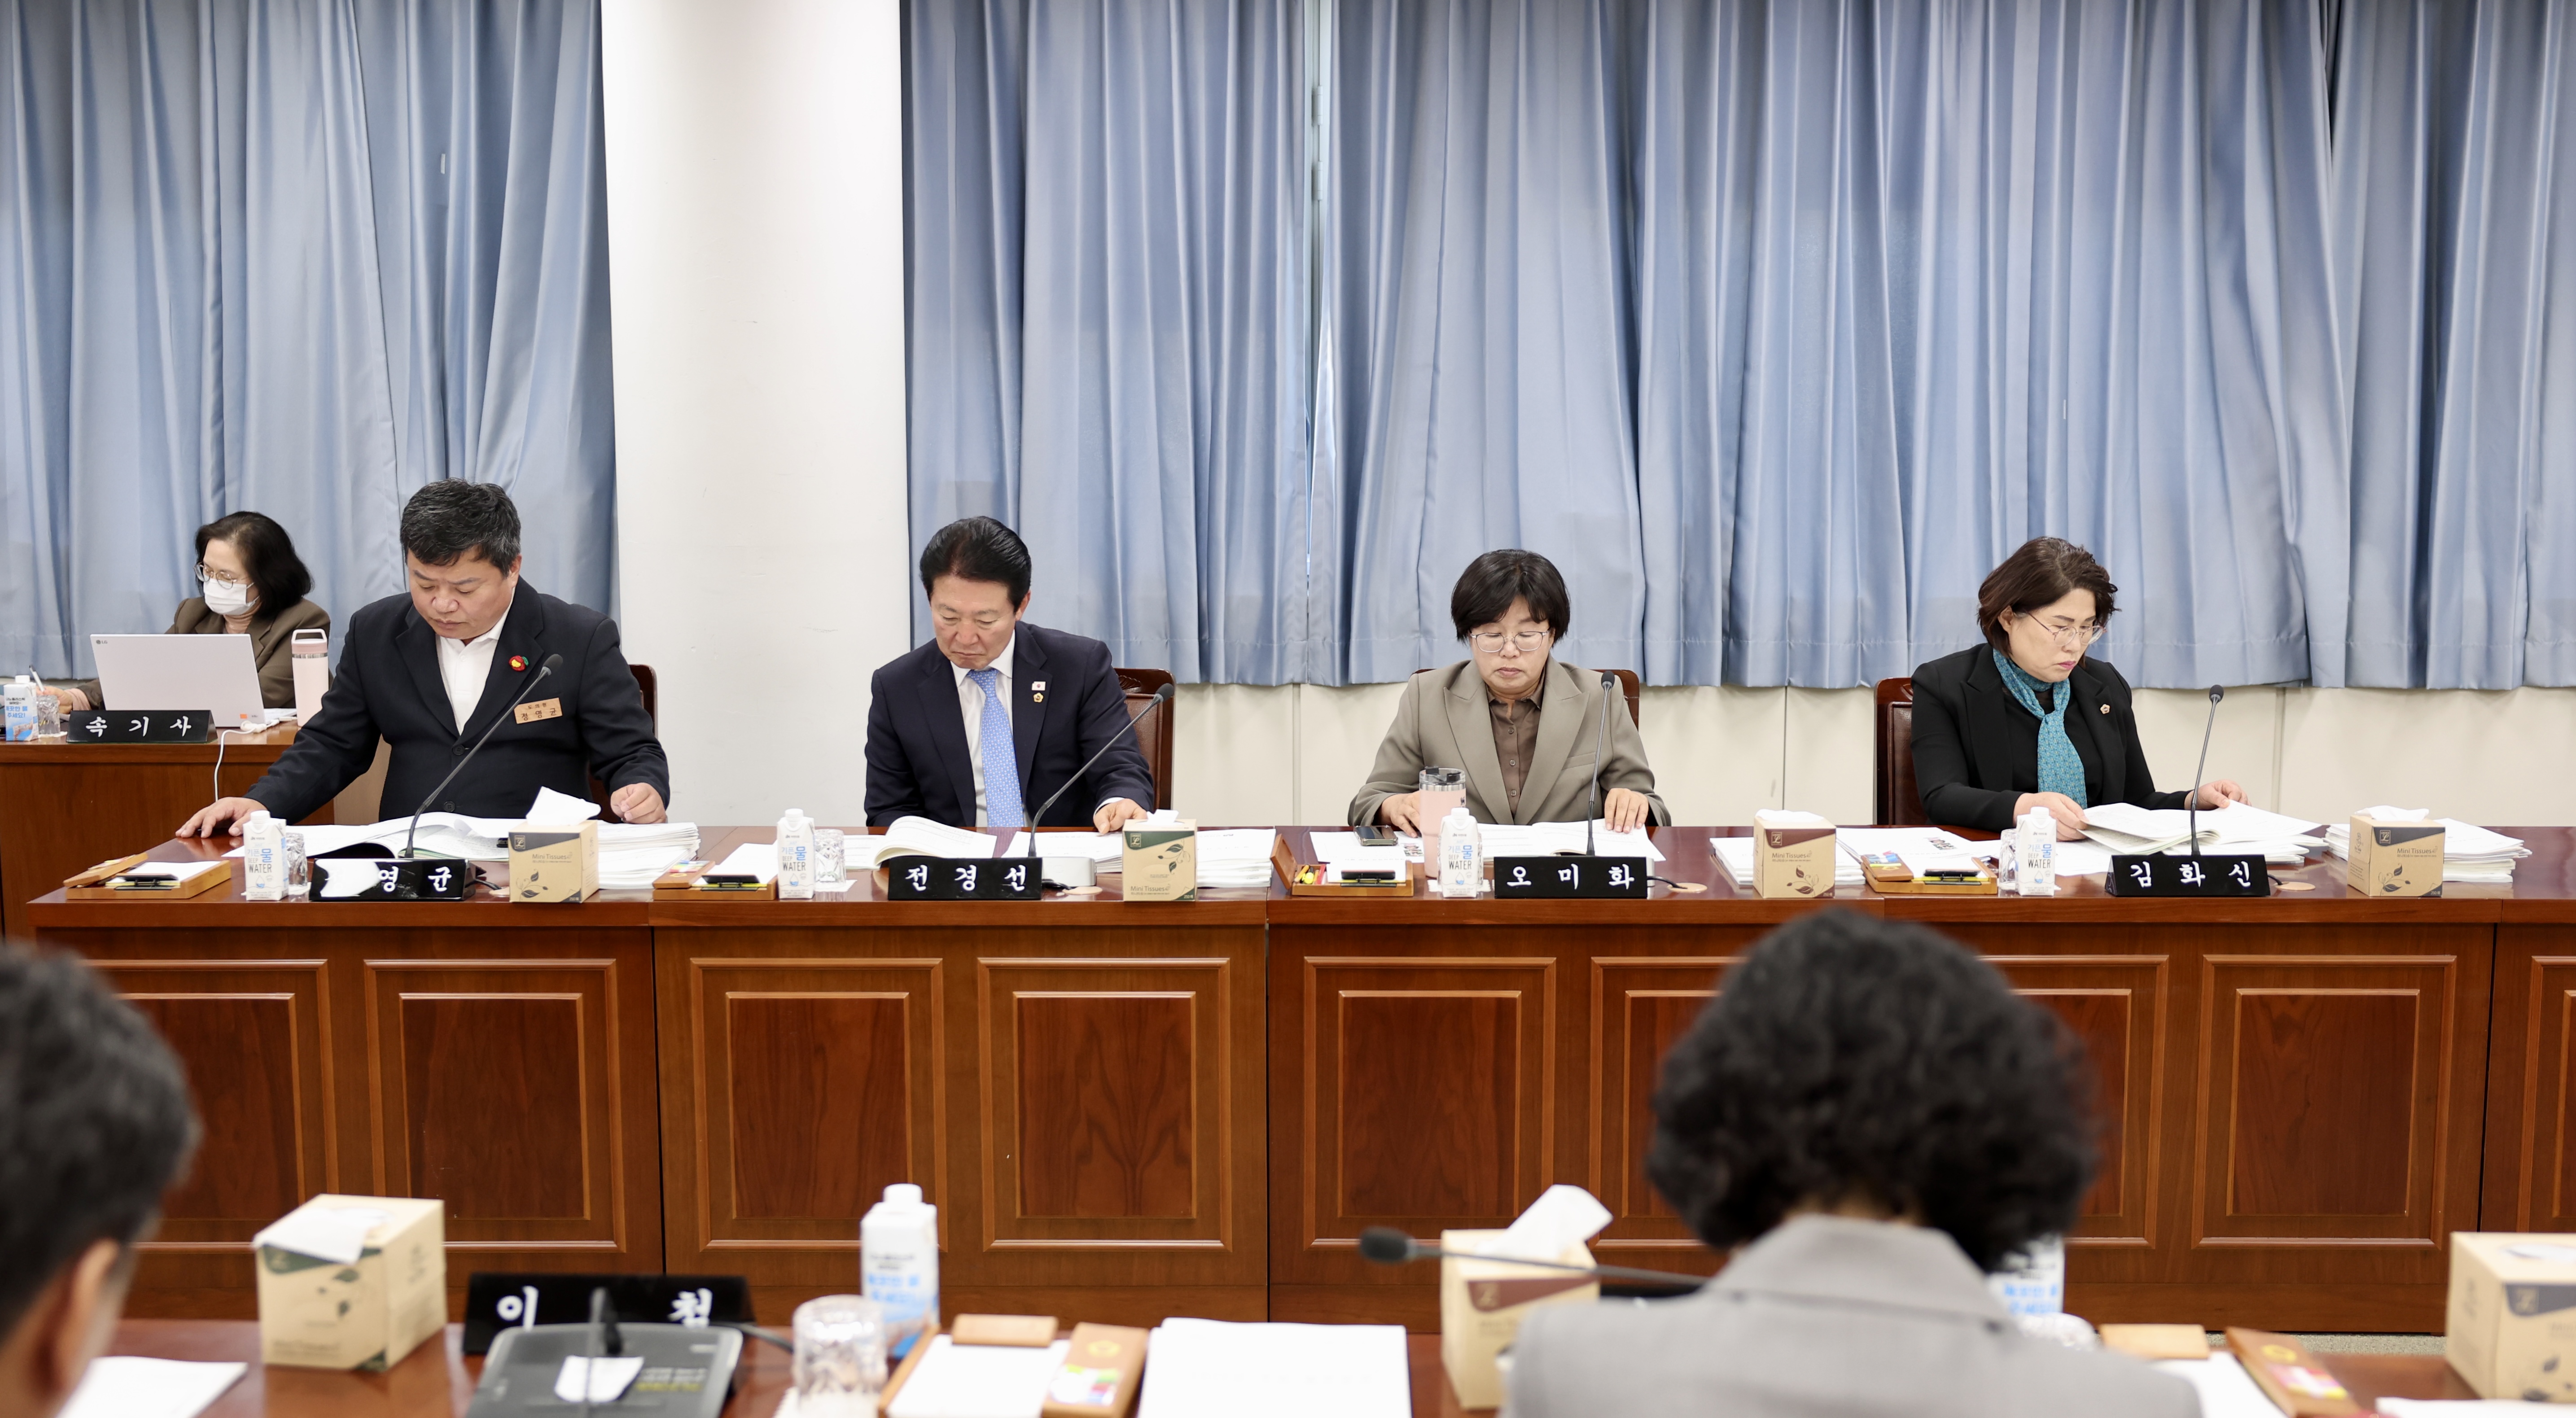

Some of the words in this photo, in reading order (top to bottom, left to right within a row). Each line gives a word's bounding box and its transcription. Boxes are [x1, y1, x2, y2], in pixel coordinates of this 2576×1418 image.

[521, 708, 557, 721] 정영균
[260, 848, 273, 863] 물
[795, 846, 807, 861] 물
[1461, 845, 1473, 860] 물
[2042, 844, 2052, 858] 물
[249, 864, 272, 873] WATER
[783, 862, 806, 871] WATER
[1449, 860, 1472, 870] WATER
[2028, 859, 2050, 868] WATER
[905, 864, 1026, 892] 전경선
[1507, 863, 1634, 890] 오미화
[2130, 861, 2251, 888] 김화신
